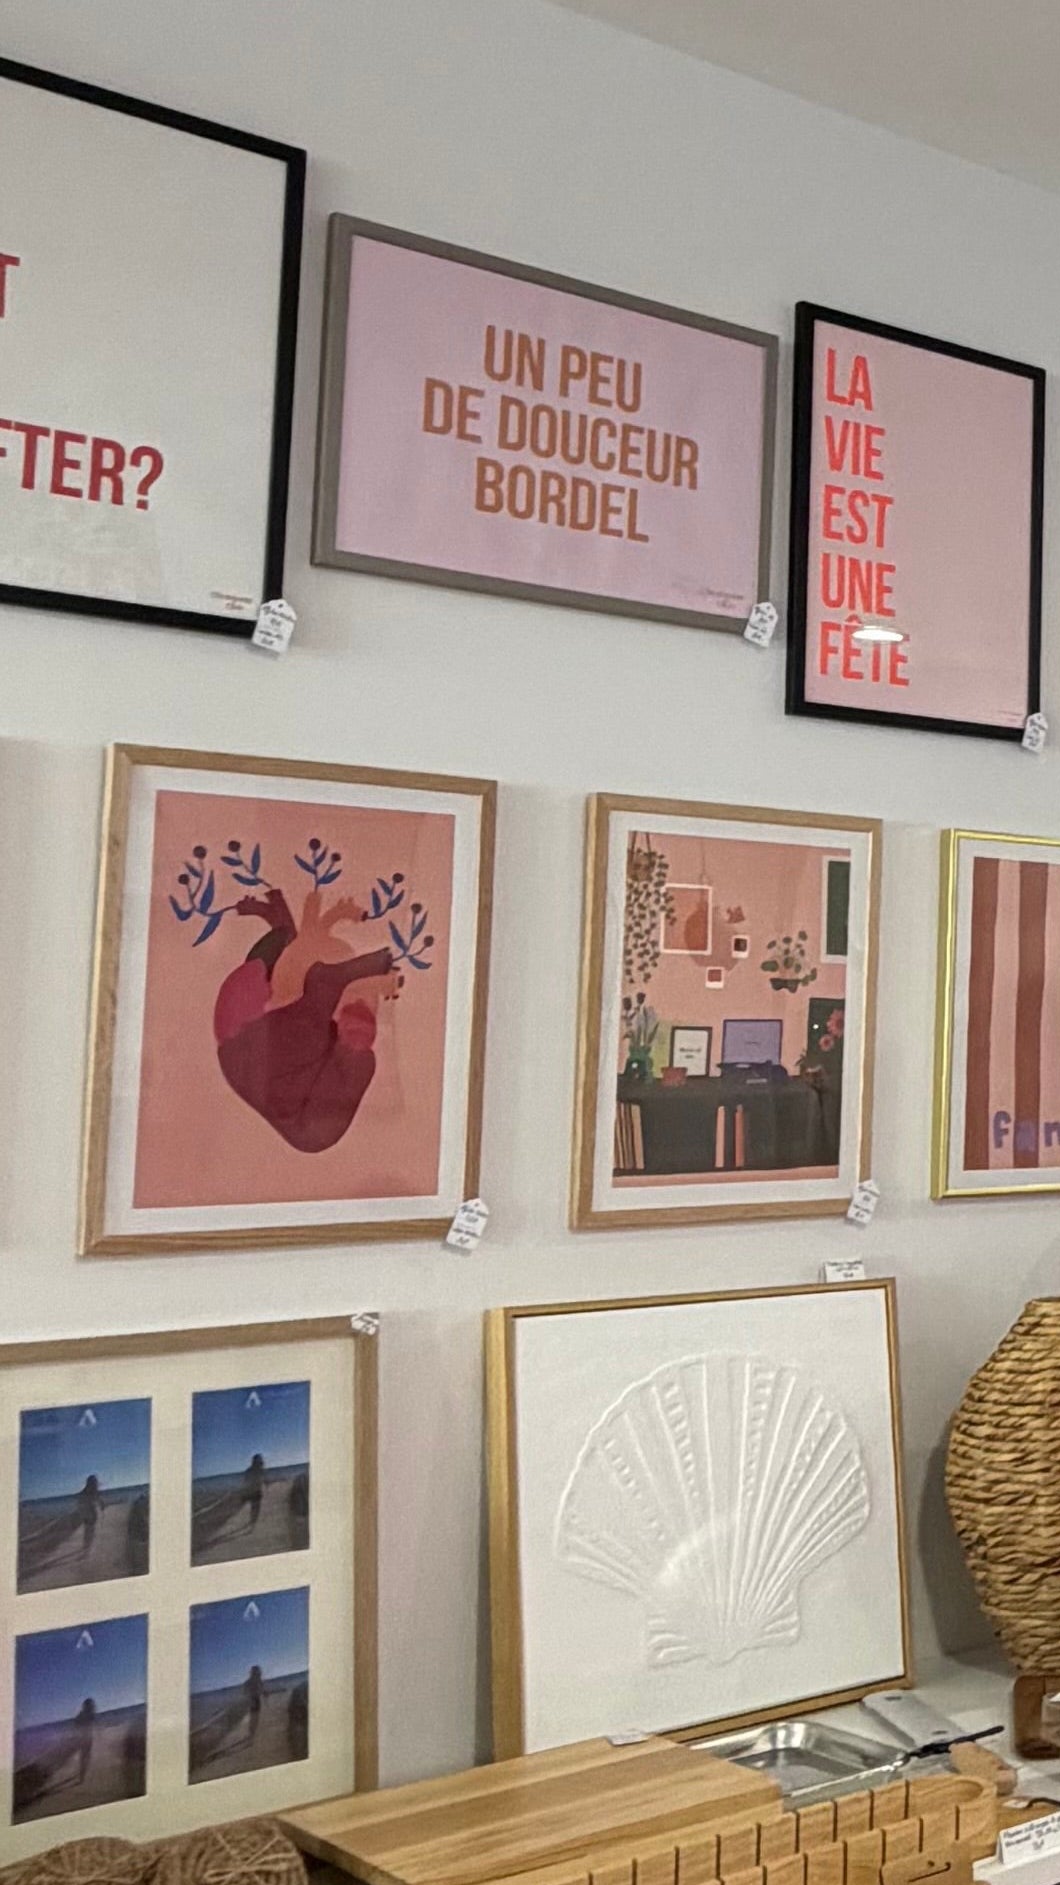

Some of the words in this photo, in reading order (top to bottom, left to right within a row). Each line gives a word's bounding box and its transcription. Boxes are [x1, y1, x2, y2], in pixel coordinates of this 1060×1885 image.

[484, 325, 543, 393] UN
[559, 345, 643, 413] PEU
[826, 348, 873, 411] LA
[423, 377, 482, 441] DE
[498, 395, 699, 490] DOUCEUR
[824, 416, 886, 481] VIE
[475, 456, 649, 543] BORDEL
[823, 484, 894, 548] EST
[822, 553, 896, 618] UNE
[820, 613, 910, 686] FÊTE
